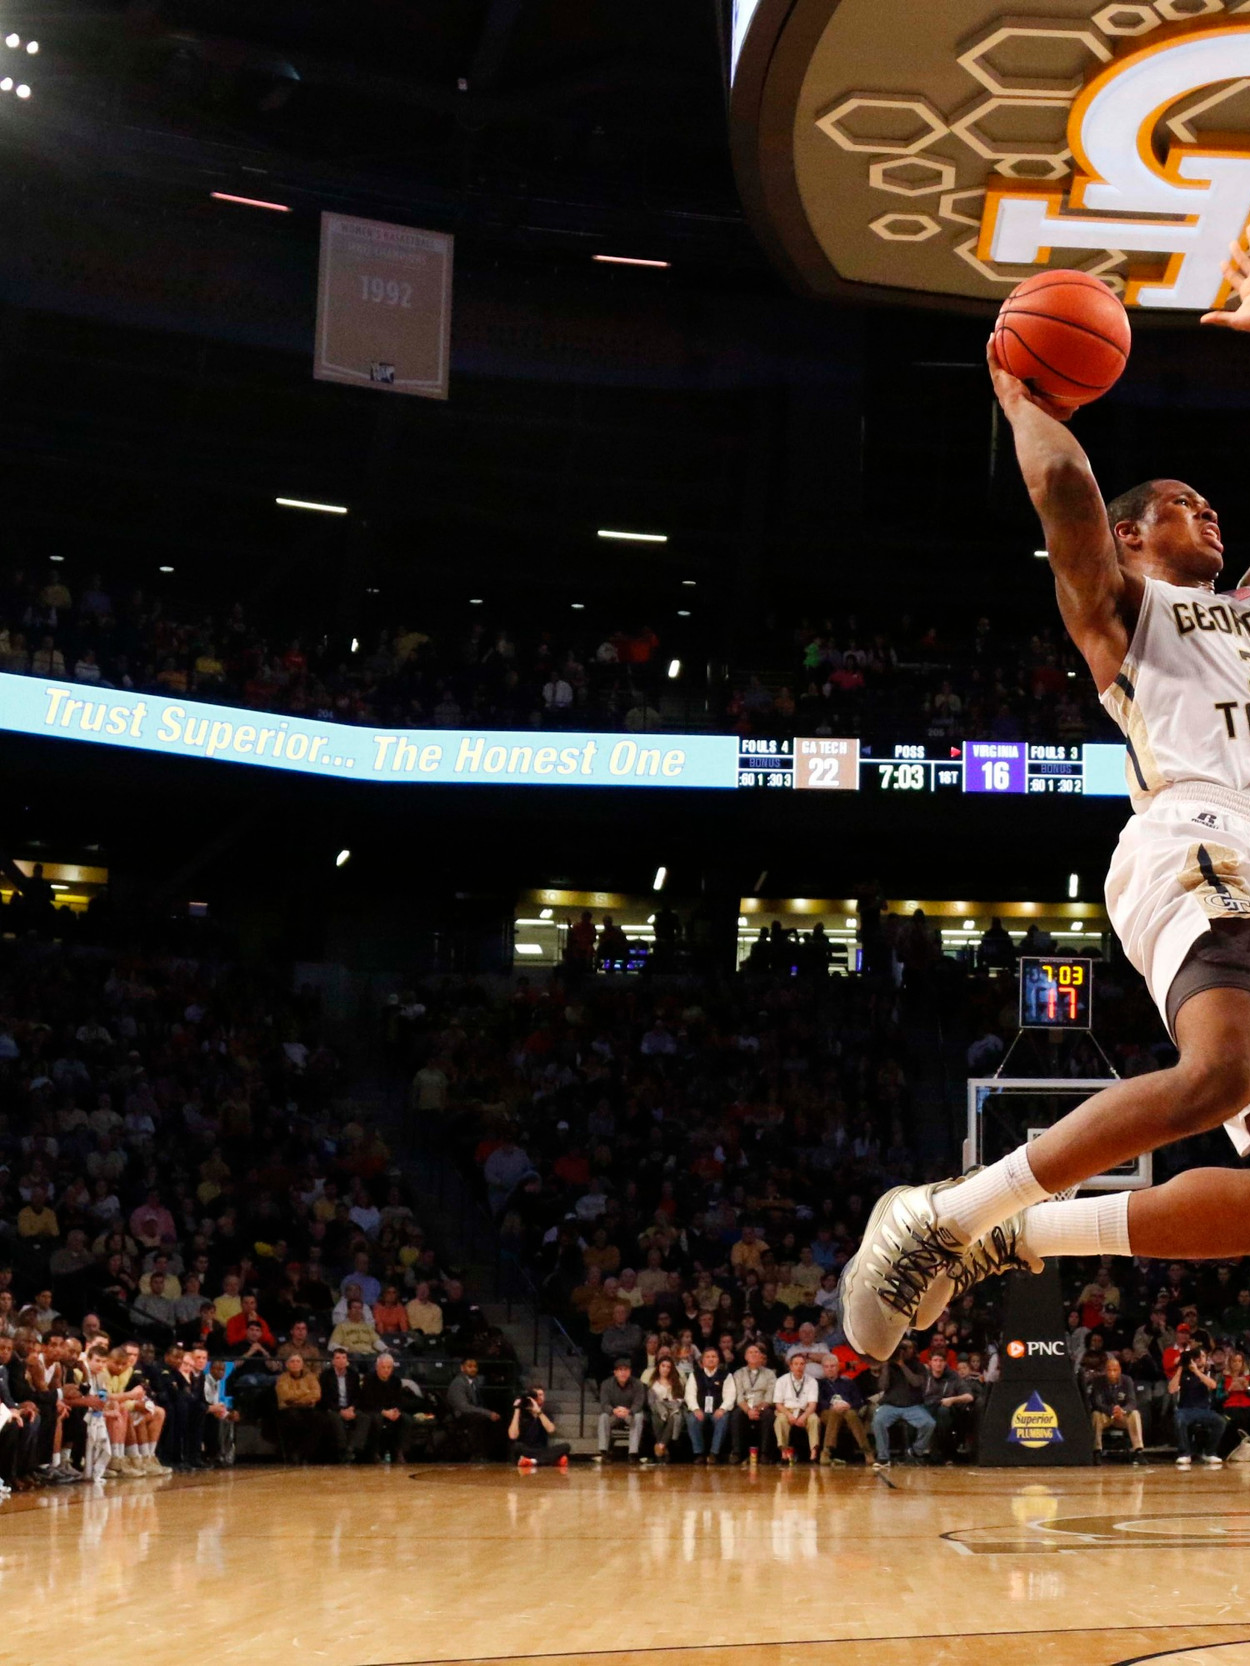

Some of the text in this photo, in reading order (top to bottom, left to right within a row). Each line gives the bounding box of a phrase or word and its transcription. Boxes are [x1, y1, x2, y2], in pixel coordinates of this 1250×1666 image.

[361, 274, 414, 309] 1992
[44, 686, 356, 769] Trust Superior...
[742, 740, 789, 753] FOULS 4
[801, 741, 847, 755] GA TECH
[895, 745, 925, 759] POSS
[973, 745, 1019, 759] VIRGINIA
[1030, 746, 1078, 760] FOULS 3
[372, 735, 687, 778] The Honest One
[749, 757, 781, 768] BONUS
[808, 758, 840, 787] 22
[981, 761, 1010, 790] 16
[1041, 764, 1073, 774] BONUS
[757, 774, 764, 786] 1
[767, 774, 783, 787] :30
[784, 774, 792, 787] 3
[878, 764, 925, 790] 7:03
[938, 771, 959, 784] 1ST
[1047, 779, 1054, 792] 1
[1057, 779, 1073, 792] :30
[1074, 779, 1082, 793] 2
[1048, 987, 1078, 1020] 17
[1026, 1341, 1065, 1356] PNC
[1015, 1413, 1054, 1427] Superior
[1016, 1427, 1054, 1439] PLUMBING
